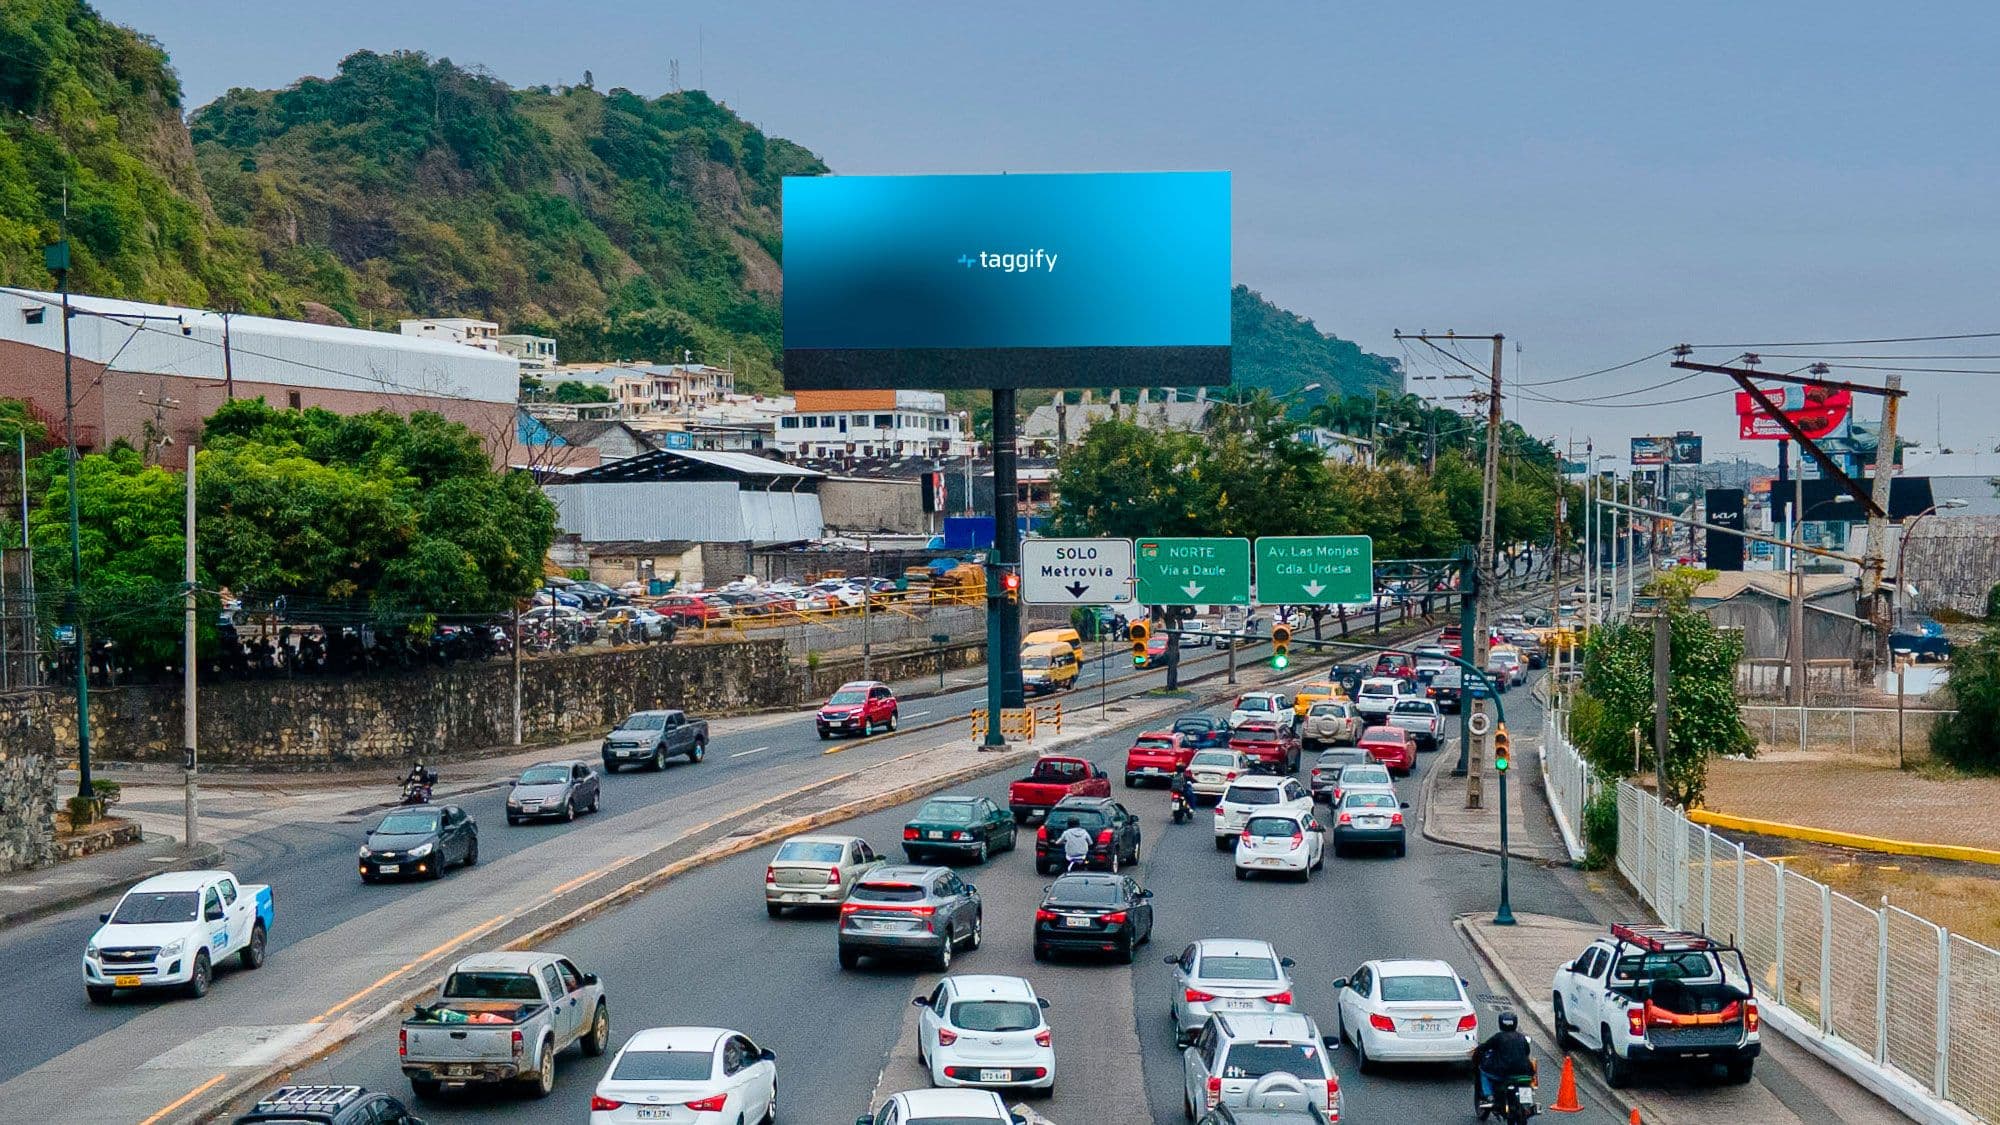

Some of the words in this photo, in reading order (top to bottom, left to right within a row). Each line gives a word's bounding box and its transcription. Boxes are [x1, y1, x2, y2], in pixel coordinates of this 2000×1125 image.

[980, 248, 1058, 273] taggify
[1056, 547, 1097, 560] SOLO
[1169, 546, 1216, 558] NORTE
[1267, 545, 1288, 557] Av.
[1291, 546, 1313, 557] Las
[1316, 544, 1360, 559] Monjas
[1182, 567, 1189, 576] a
[1192, 564, 1226, 576] Daule
[1308, 562, 1352, 575] Urdesa
